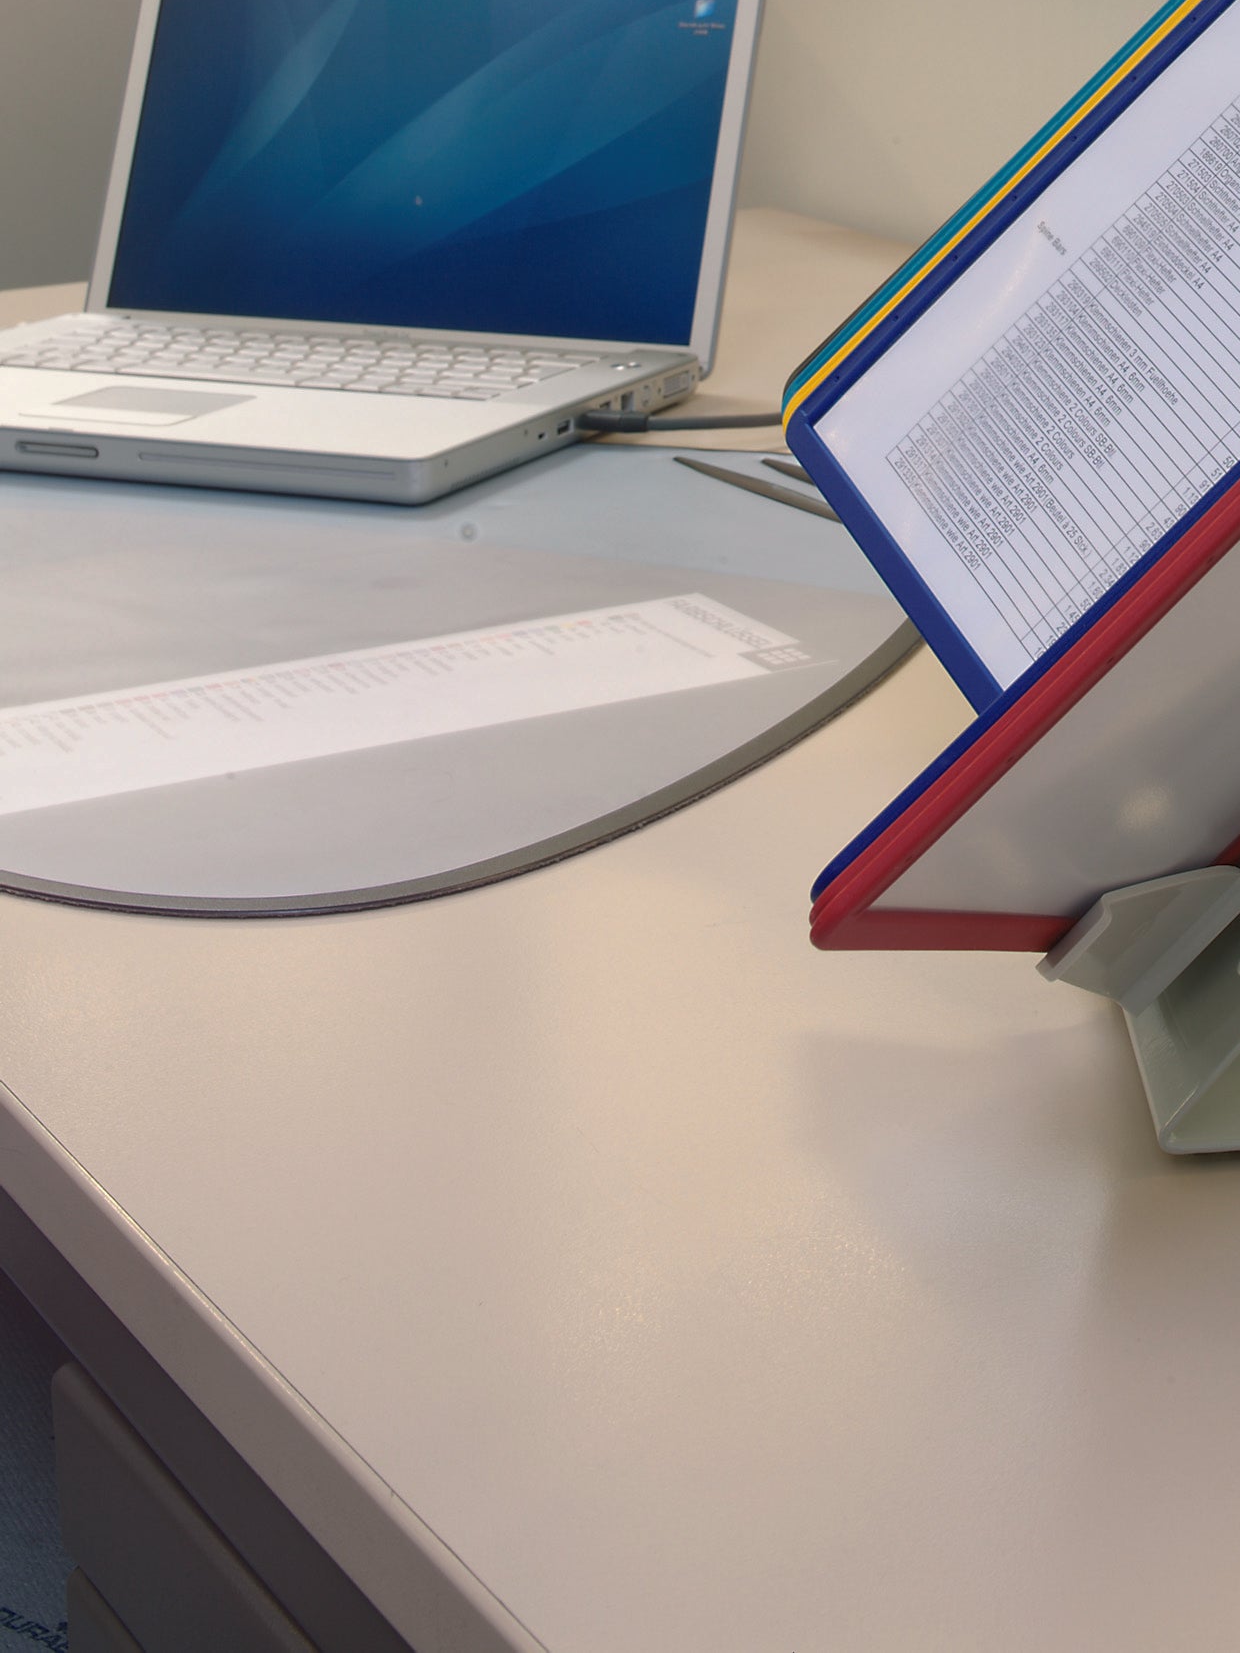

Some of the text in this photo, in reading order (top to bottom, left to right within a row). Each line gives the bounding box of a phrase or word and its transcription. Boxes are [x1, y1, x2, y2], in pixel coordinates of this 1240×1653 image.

[1187, 157, 1212, 183] 271503
[1176, 168, 1240, 234] 271504 Sichthefter A4
[1034, 219, 1069, 256] Spine Bars
[1175, 212, 1215, 254] Schnellhefter
[1209, 248, 1223, 263] A4
[1186, 201, 1226, 242] Schnellhefter
[1220, 237, 1235, 251] A4
[1141, 245, 1178, 284] Flexi-Hefter
[1163, 223, 1212, 274] Schnellhefter A4
[1119, 268, 1156, 307] Flexi-Hefter
[1130, 257, 1167, 296] Flexi-Hefter
[1191, 275, 1205, 290] A4
[1064, 323, 1135, 405] Klemmschienen 6mm
[1075, 312, 1147, 393] Klemmschienen 6mm
[1086, 301, 1133, 353] Klemmschienen
[1132, 354, 1148, 371] mm
[1144, 366, 1180, 406] Fuellhoehe
[1041, 345, 1112, 428] Klemmschienen 6mm
[1053, 334, 1124, 416] Klemmschienen 6mm
[1061, 418, 1087, 449] Colours
[1072, 407, 1099, 437] Colours
[1039, 441, 1065, 472] Colours
[1050, 430, 1076, 460] Colours
[989, 480, 1005, 498] wie
[1001, 469, 1016, 486] wie
[1036, 463, 1055, 485] 6mm
[967, 503, 982, 521] wie
[978, 491, 993, 509] wie
[1012, 457, 1027, 475] wie
[1065, 524, 1078, 539] 25
[944, 526, 960, 544] wie
[956, 514, 971, 532] wie
